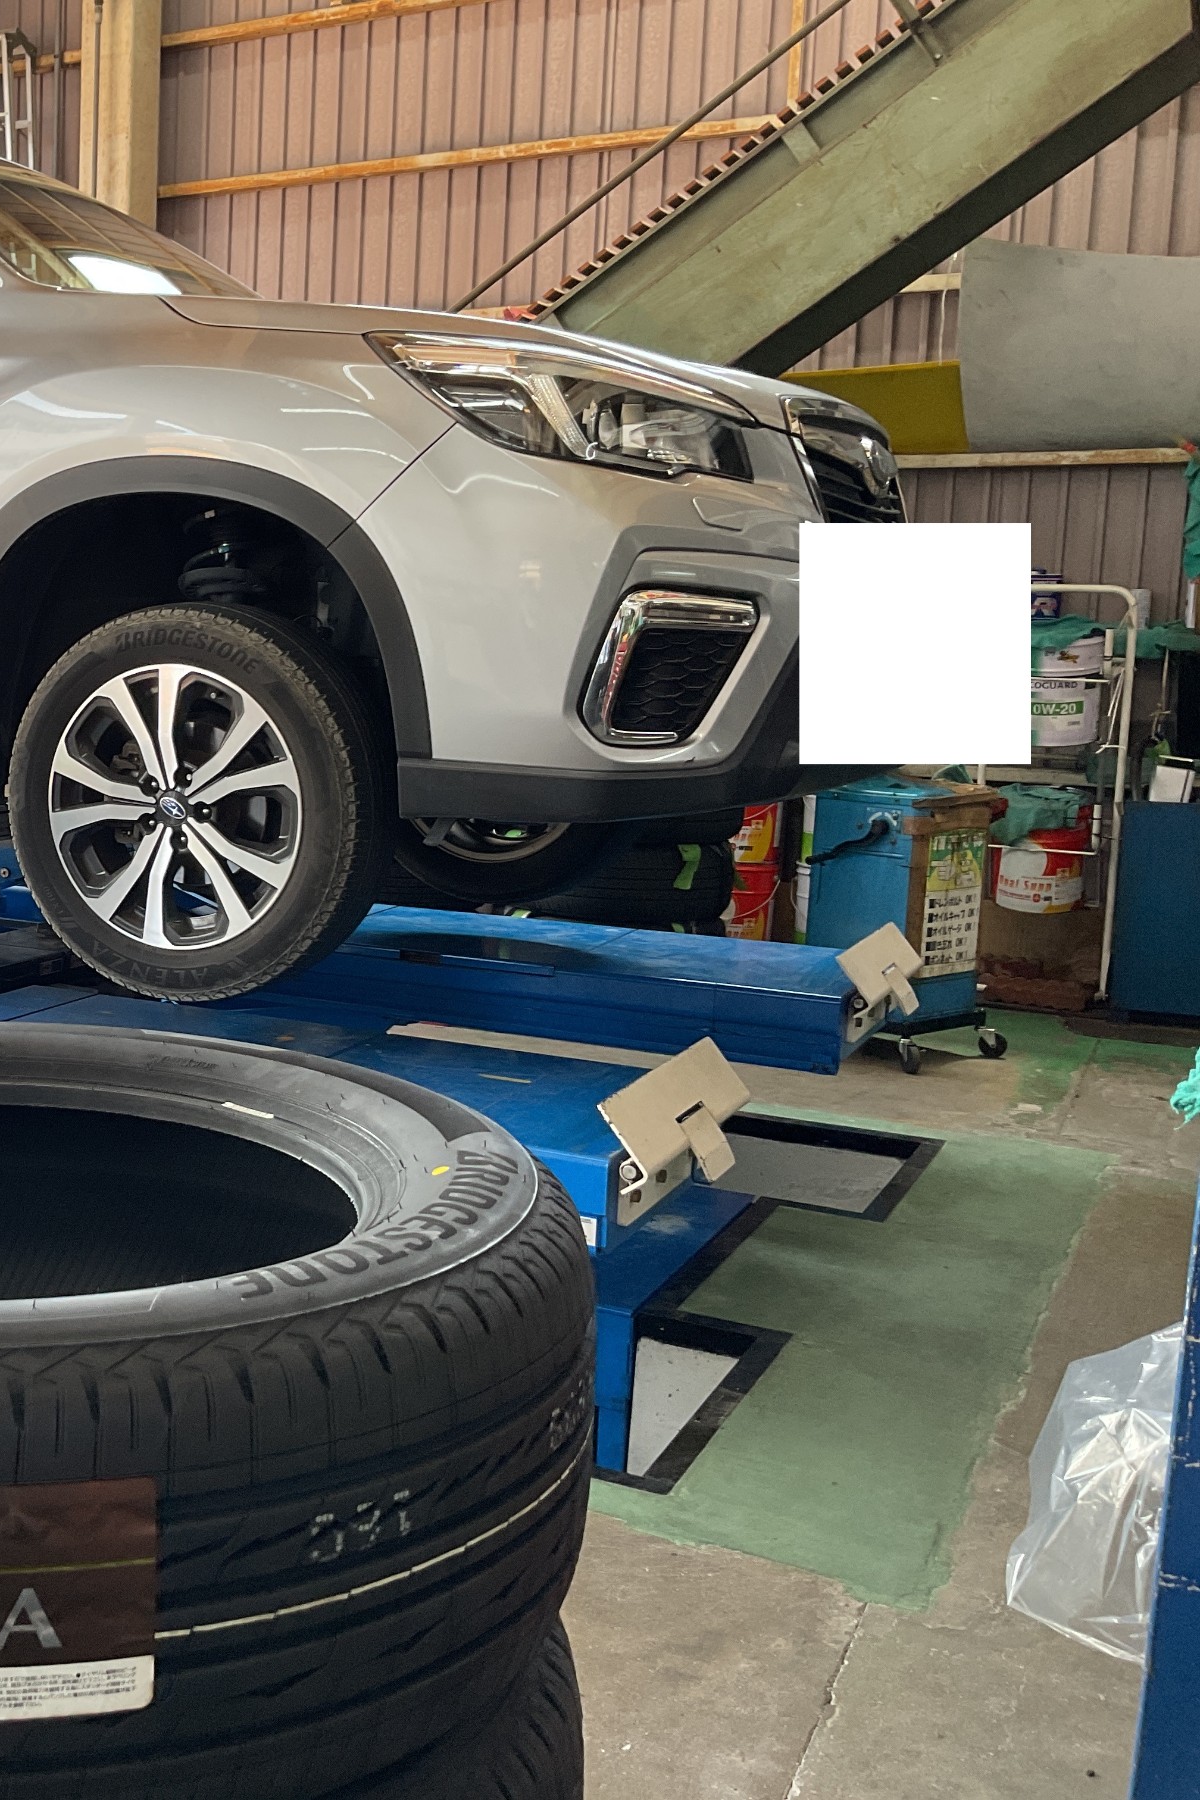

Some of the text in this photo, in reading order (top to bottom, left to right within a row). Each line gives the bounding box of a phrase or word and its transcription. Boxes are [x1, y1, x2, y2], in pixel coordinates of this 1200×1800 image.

[115, 628, 260, 675] BRIDGESTONE
[1033, 703, 1077, 715] 0W-20
[232, 1150, 519, 1300] BRIDGESTONE
